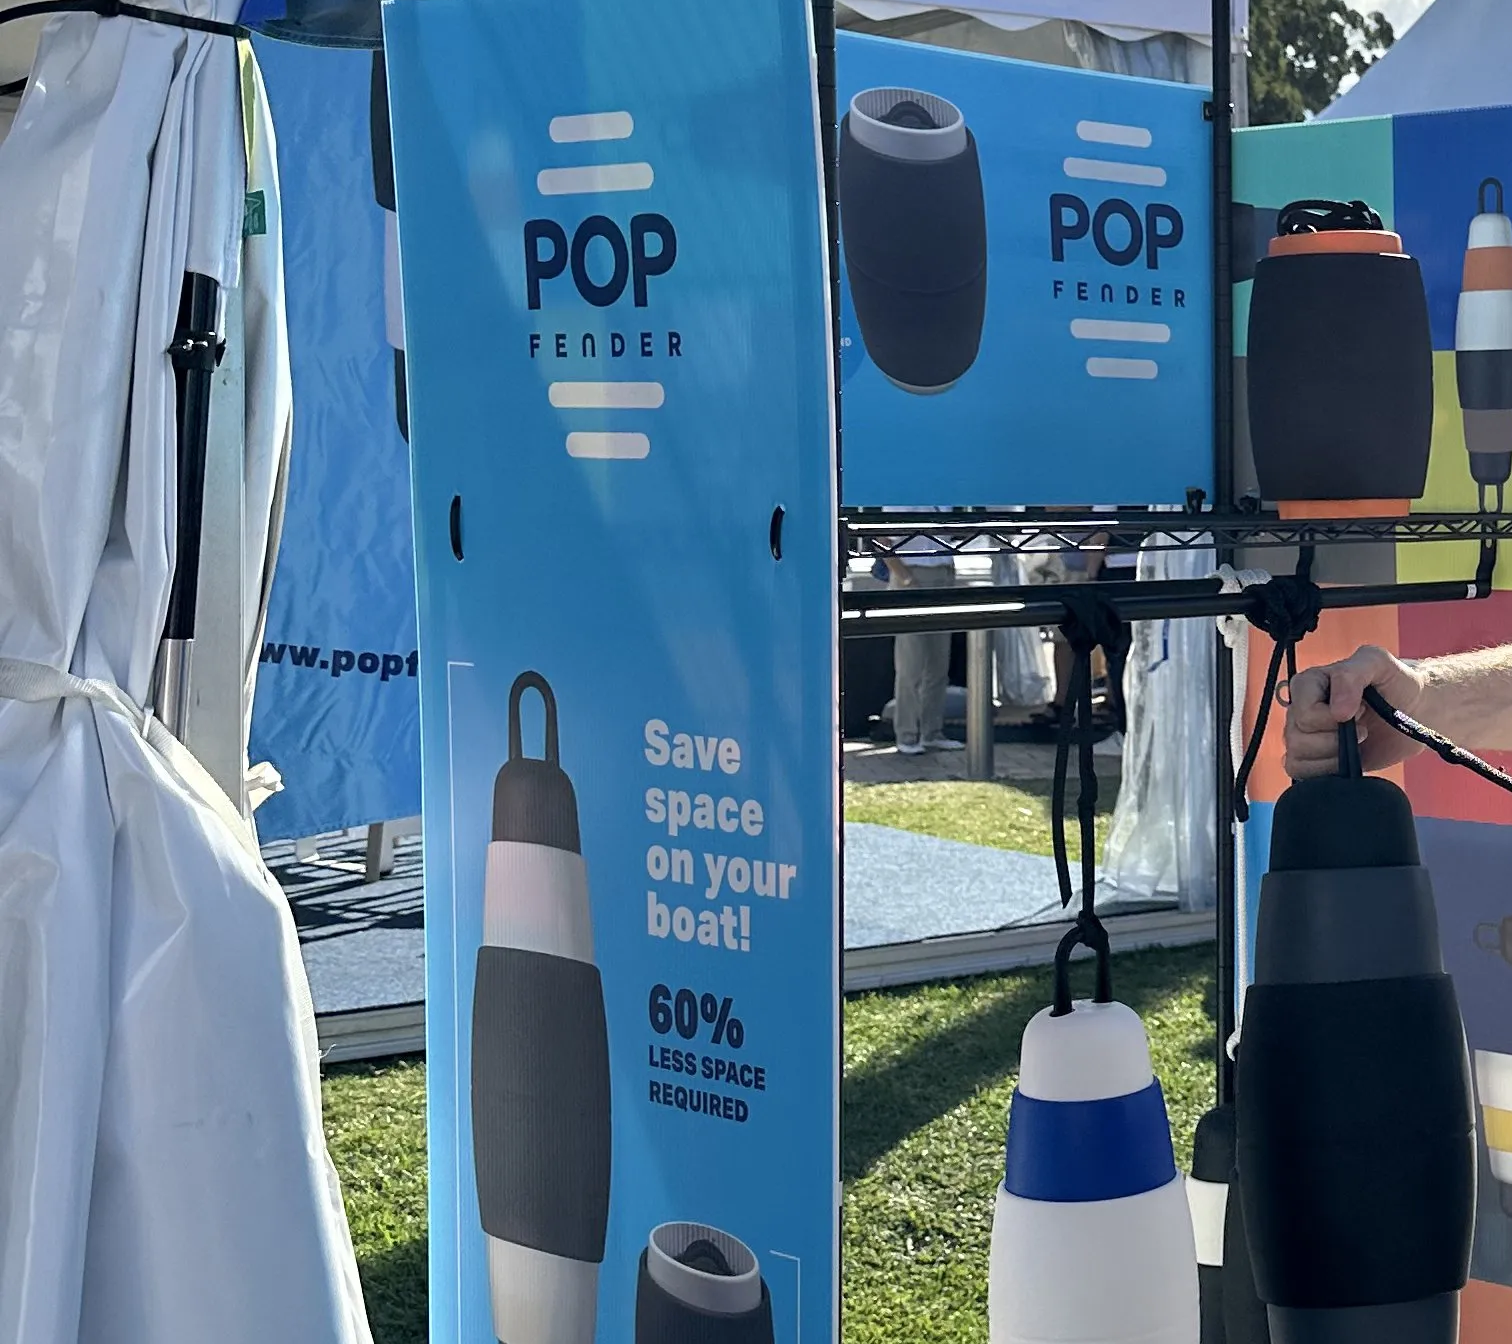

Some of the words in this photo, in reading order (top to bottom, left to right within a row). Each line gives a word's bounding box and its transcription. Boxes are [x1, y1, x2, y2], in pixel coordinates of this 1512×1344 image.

[1049, 192, 1184, 271] POP
[523, 212, 677, 311] POP
[644, 718, 742, 776] Save
[644, 786, 765, 837] space
[646, 845, 695, 886] on
[703, 851, 797, 900] your
[646, 891, 751, 953] boat!
[647, 982, 746, 1050] 60%
[648, 1043, 698, 1076] LESS
[700, 1057, 767, 1092] SPACE
[648, 1079, 749, 1124] REQUIRED
